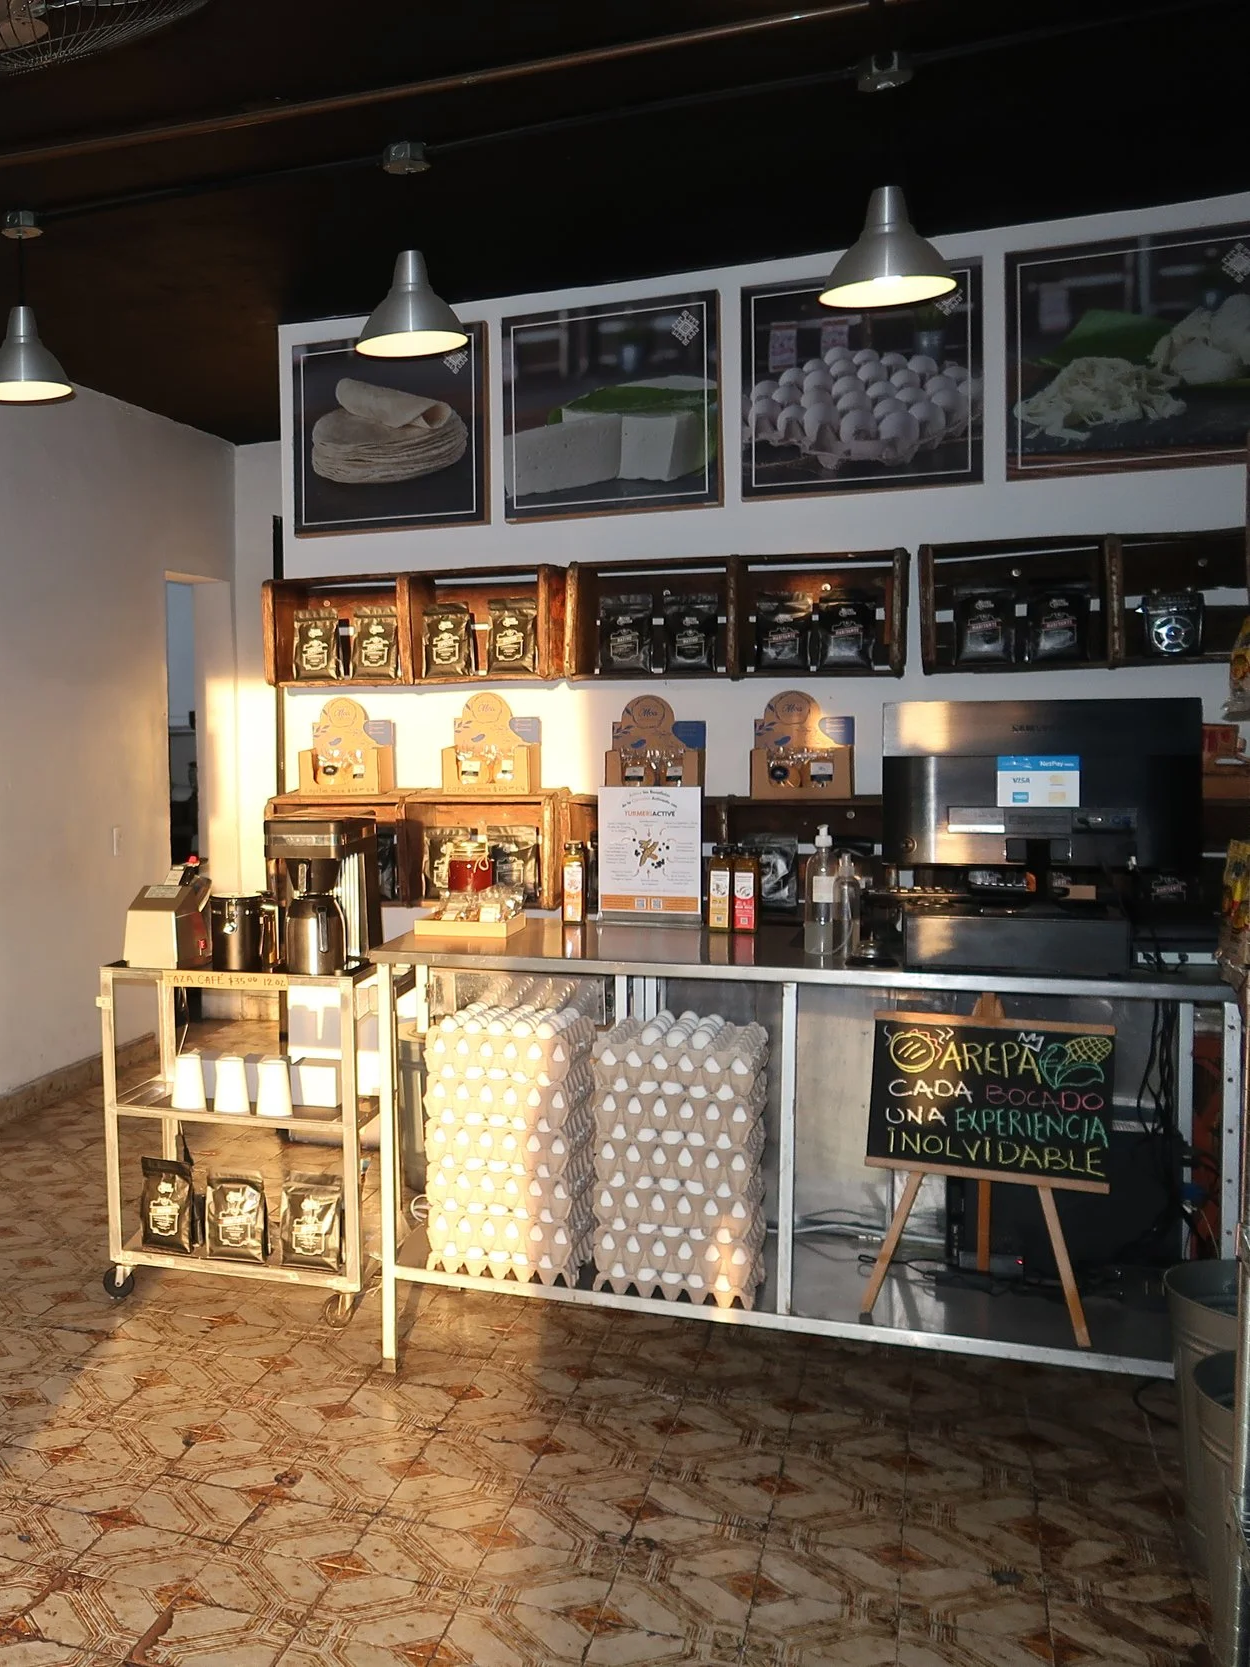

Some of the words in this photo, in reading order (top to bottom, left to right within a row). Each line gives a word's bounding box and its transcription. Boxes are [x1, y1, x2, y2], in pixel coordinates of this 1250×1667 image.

[1039, 760, 1064, 768] NetPay
[166, 974, 194, 984] TAZA
[197, 973, 225, 985] CAFÉ
[938, 1040, 1043, 1085] AREPA
[888, 1078, 974, 1104] CADA
[985, 1084, 1105, 1119] BOCADO
[885, 1104, 948, 1127] UNA
[955, 1106, 1110, 1149] EXPERIENCIA
[887, 1126, 1107, 1178] INOLVIDABLE
